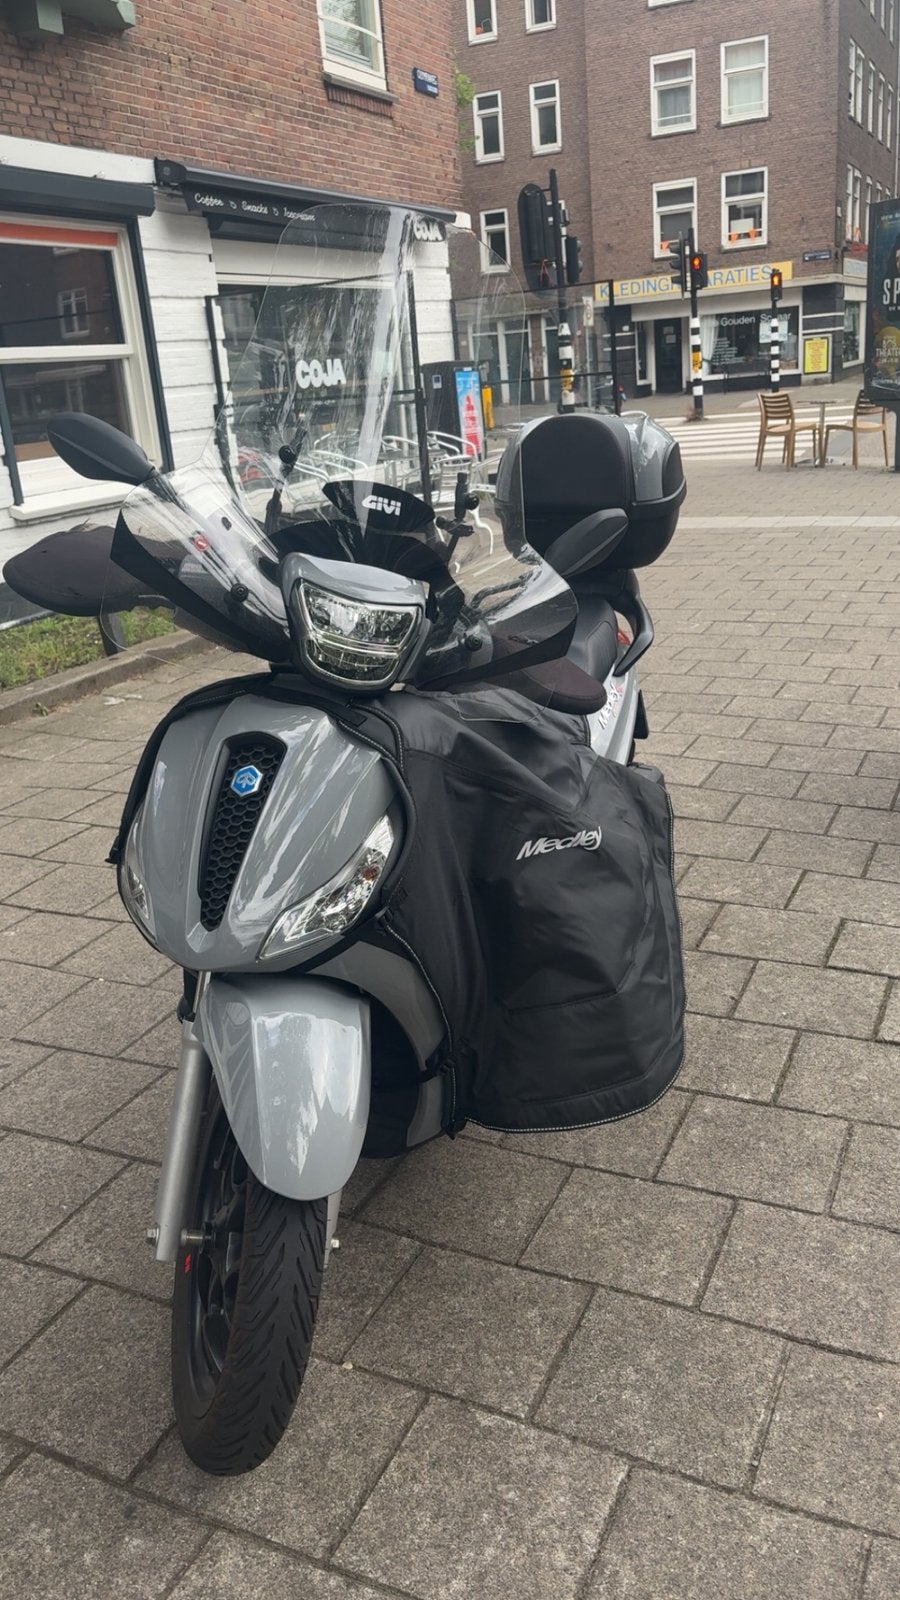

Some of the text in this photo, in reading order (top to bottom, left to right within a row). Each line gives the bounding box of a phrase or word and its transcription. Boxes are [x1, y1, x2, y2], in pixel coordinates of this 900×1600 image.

[241, 200, 269, 215] Snacks
[720, 315, 756, 327] Gouden
[295, 358, 346, 389] COJA
[361, 494, 402, 516] GIVI
[515, 826, 602, 861] Medley
